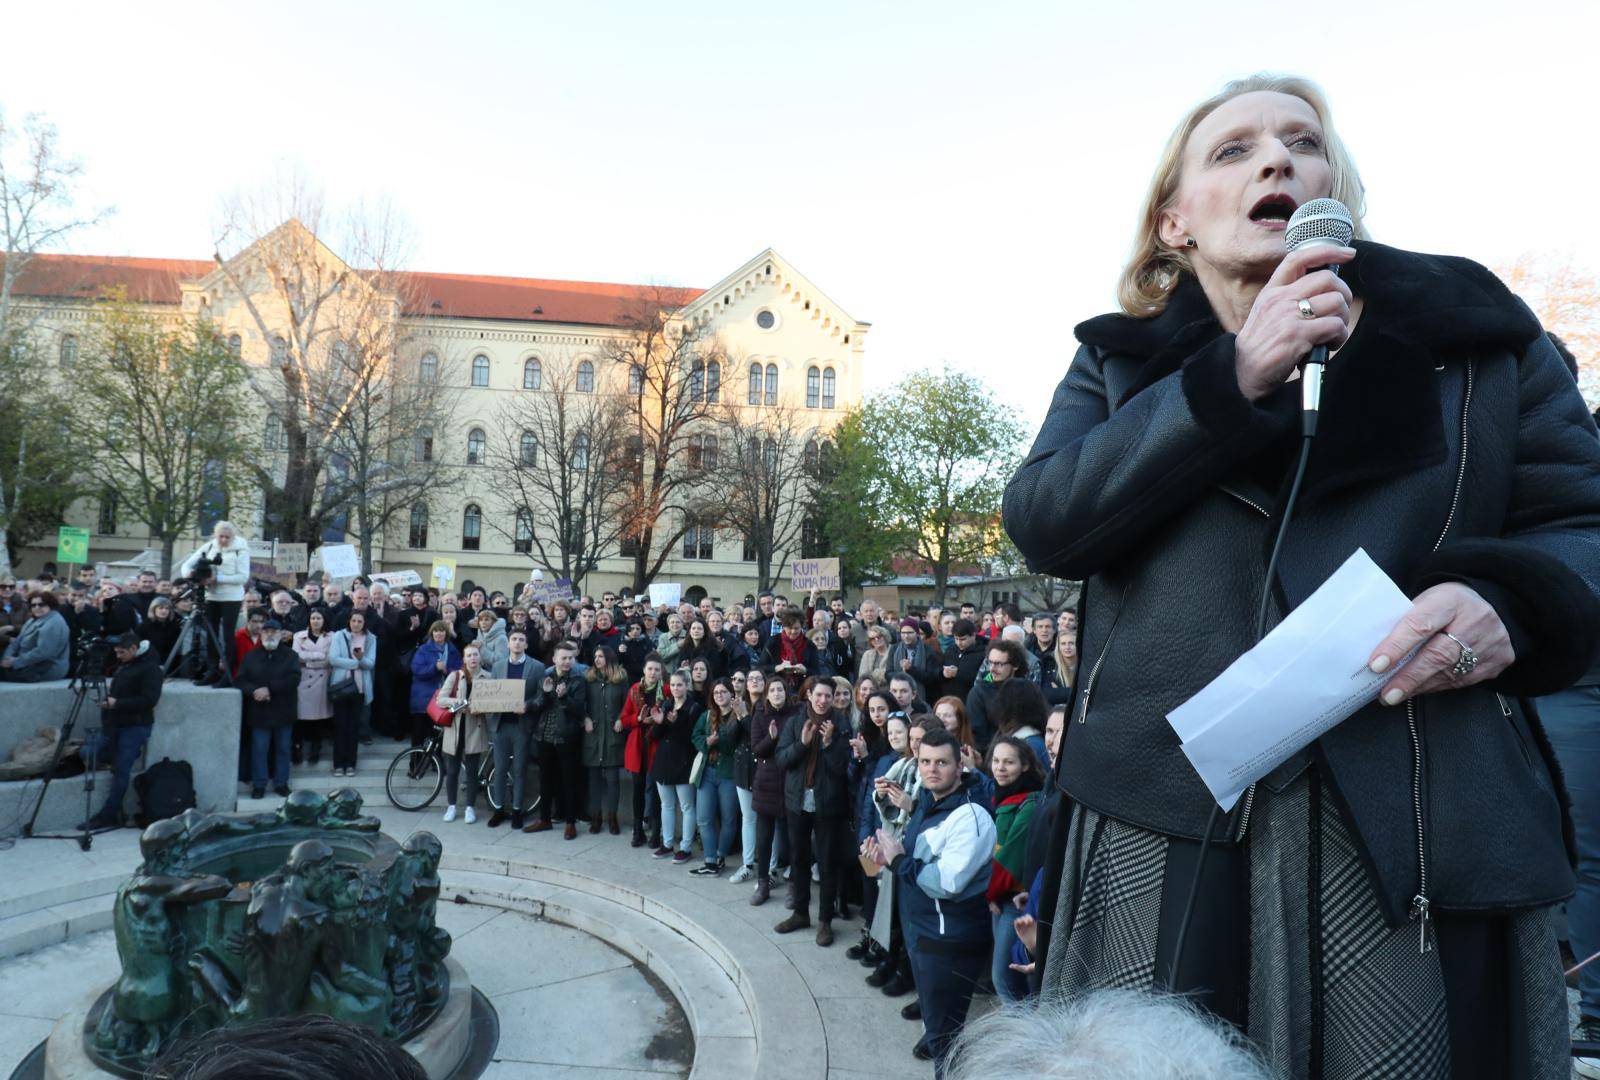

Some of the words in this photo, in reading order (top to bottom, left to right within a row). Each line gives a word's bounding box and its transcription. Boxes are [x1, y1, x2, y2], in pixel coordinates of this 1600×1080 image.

[793, 562, 819, 576] KUM
[793, 577, 818, 590] KUMA
[820, 575, 839, 589] MIJE
